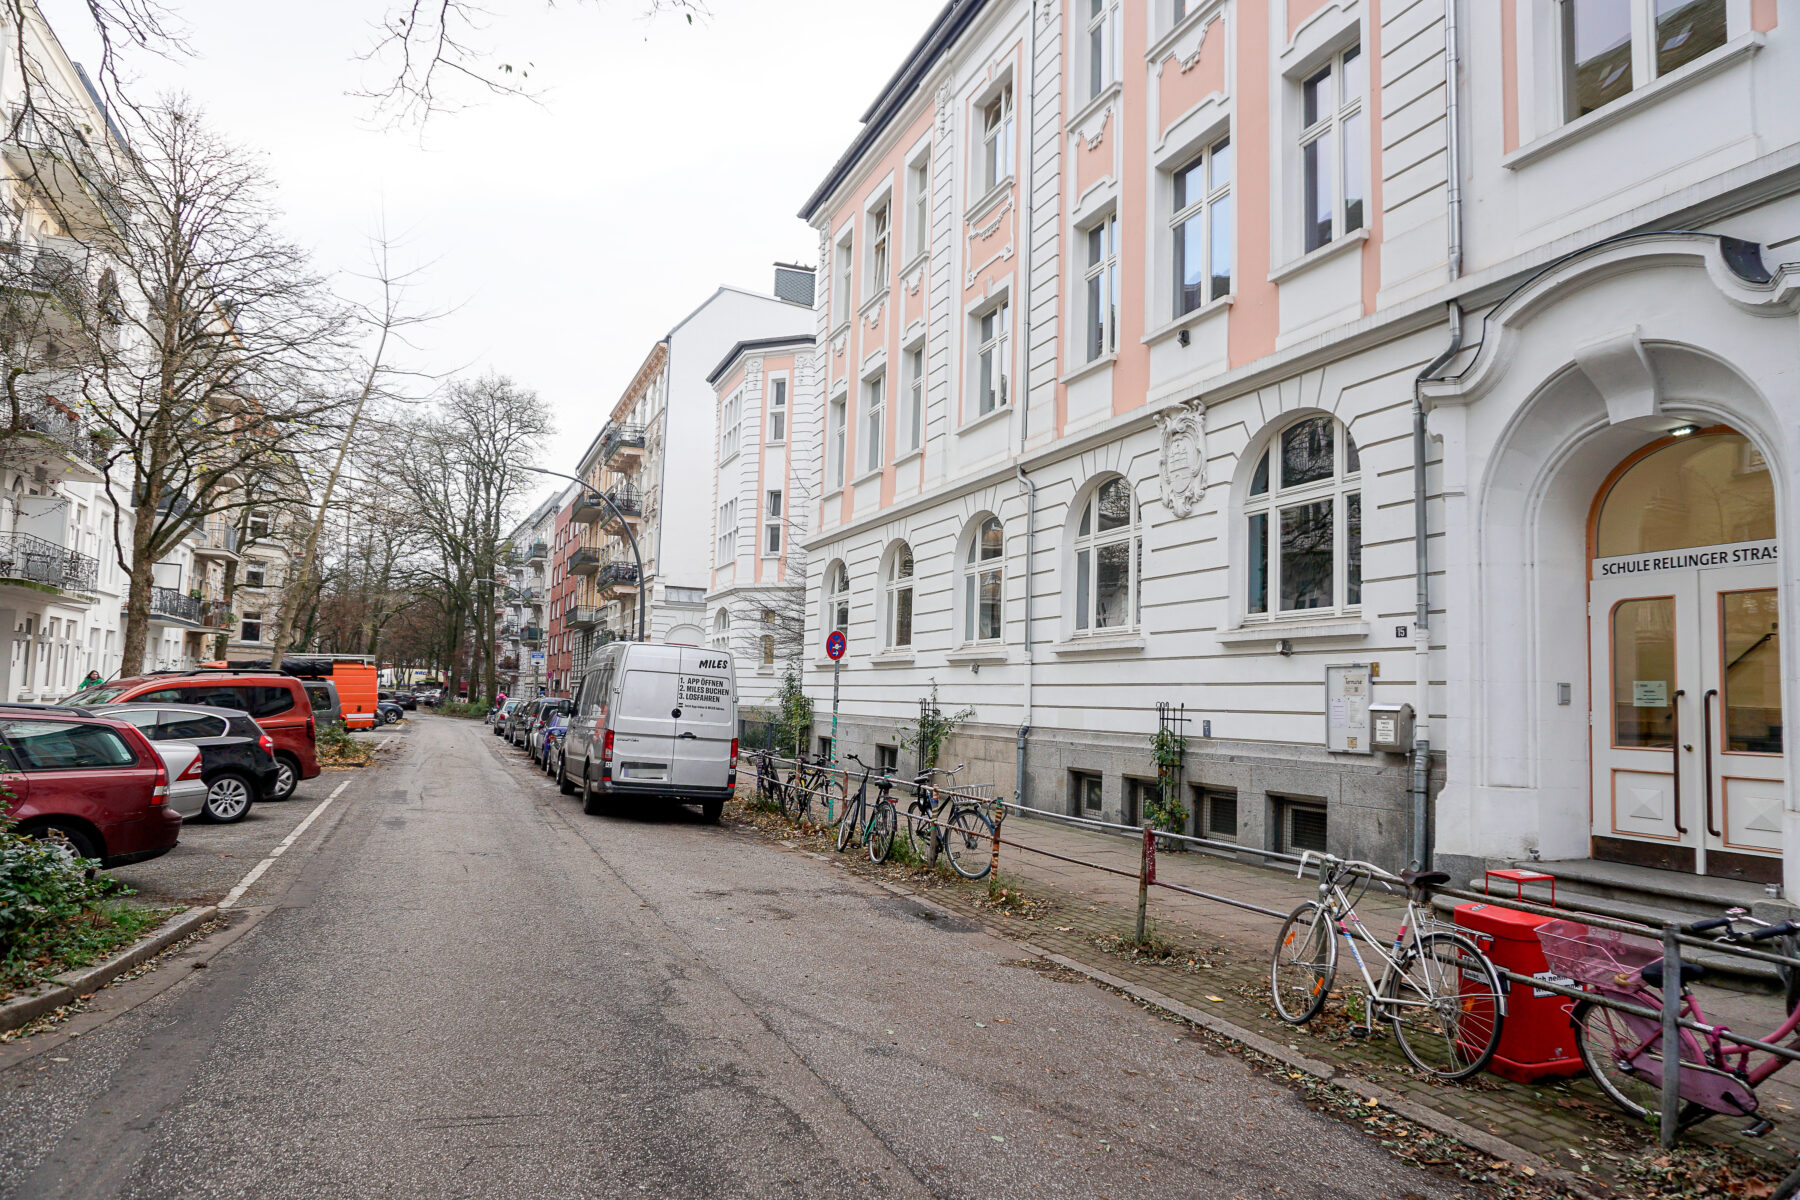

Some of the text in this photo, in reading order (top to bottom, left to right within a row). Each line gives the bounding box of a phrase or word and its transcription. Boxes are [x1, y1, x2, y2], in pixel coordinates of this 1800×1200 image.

[1602, 559, 1650, 575] SCHULE
[1653, 551, 1728, 570] RELLINGER
[1397, 626, 1406, 637] 15
[699, 660, 728, 669] MILES
[700, 678, 724, 687] ÖFFNEN
[686, 685, 705, 694] MILES
[705, 687, 730, 696] BUCHEN
[686, 693, 720, 703] LOSFAHREN
